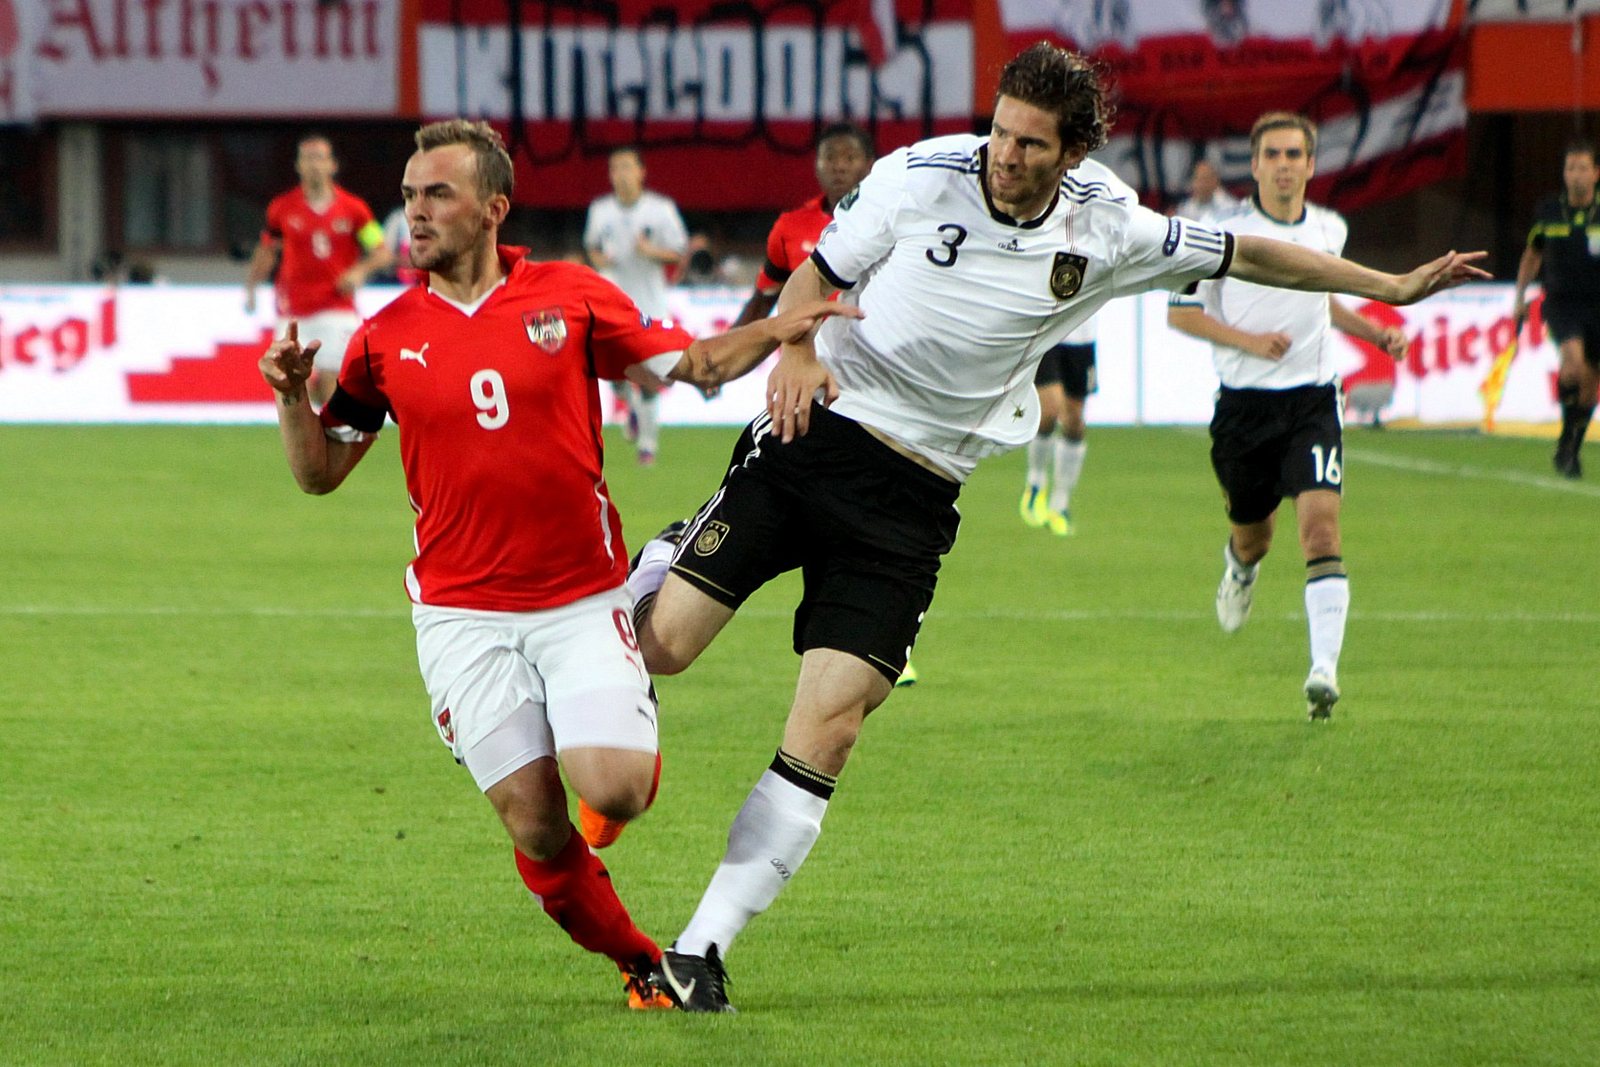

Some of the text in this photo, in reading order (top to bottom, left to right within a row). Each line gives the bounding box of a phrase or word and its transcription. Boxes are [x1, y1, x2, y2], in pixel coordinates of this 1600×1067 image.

[926, 223, 967, 267] 3
[470, 369, 510, 430] 9
[1311, 445, 1341, 485] 16
